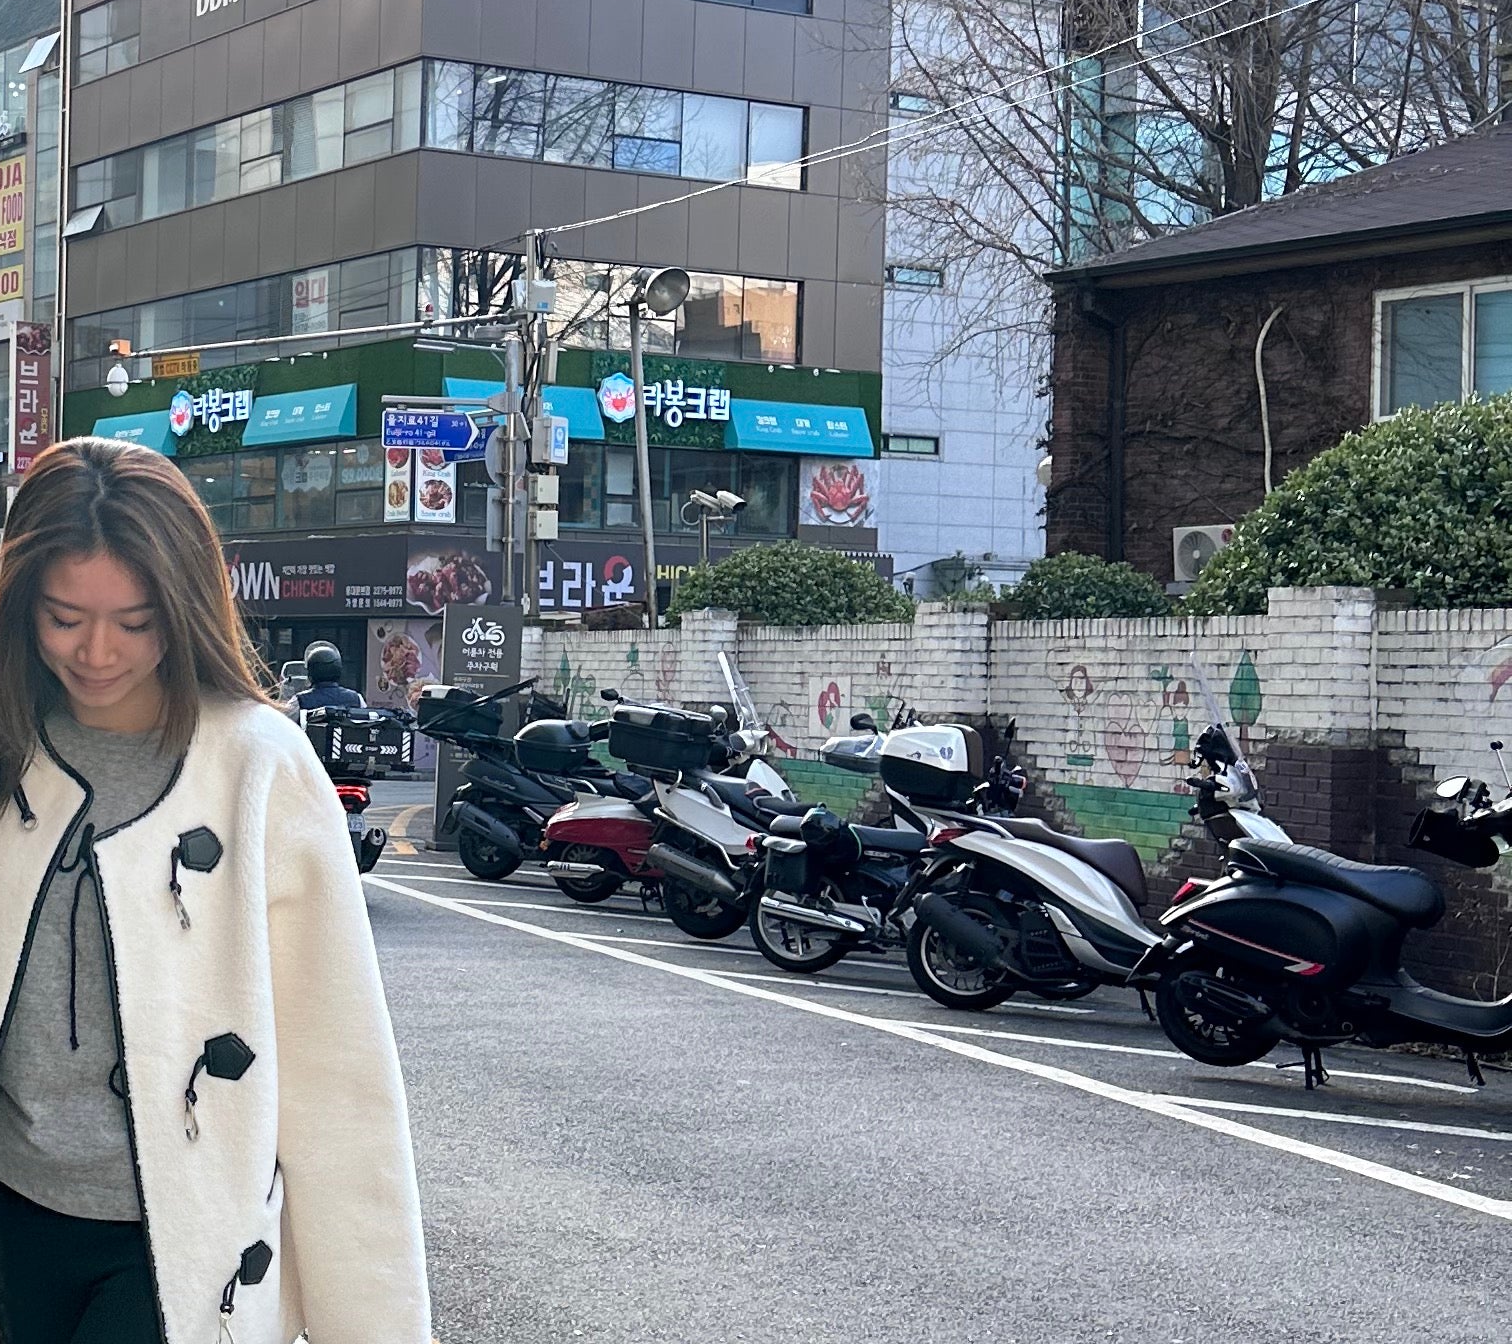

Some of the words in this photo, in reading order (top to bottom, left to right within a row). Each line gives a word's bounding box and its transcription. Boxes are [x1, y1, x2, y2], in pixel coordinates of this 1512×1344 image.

[1, 191, 24, 226] FOOD
[193, 388, 254, 433] 라봉크랩
[387, 414, 438, 428] 을지로41길
[643, 379, 731, 428] 라봉크랩
[281, 579, 335, 598] CHICKEN
